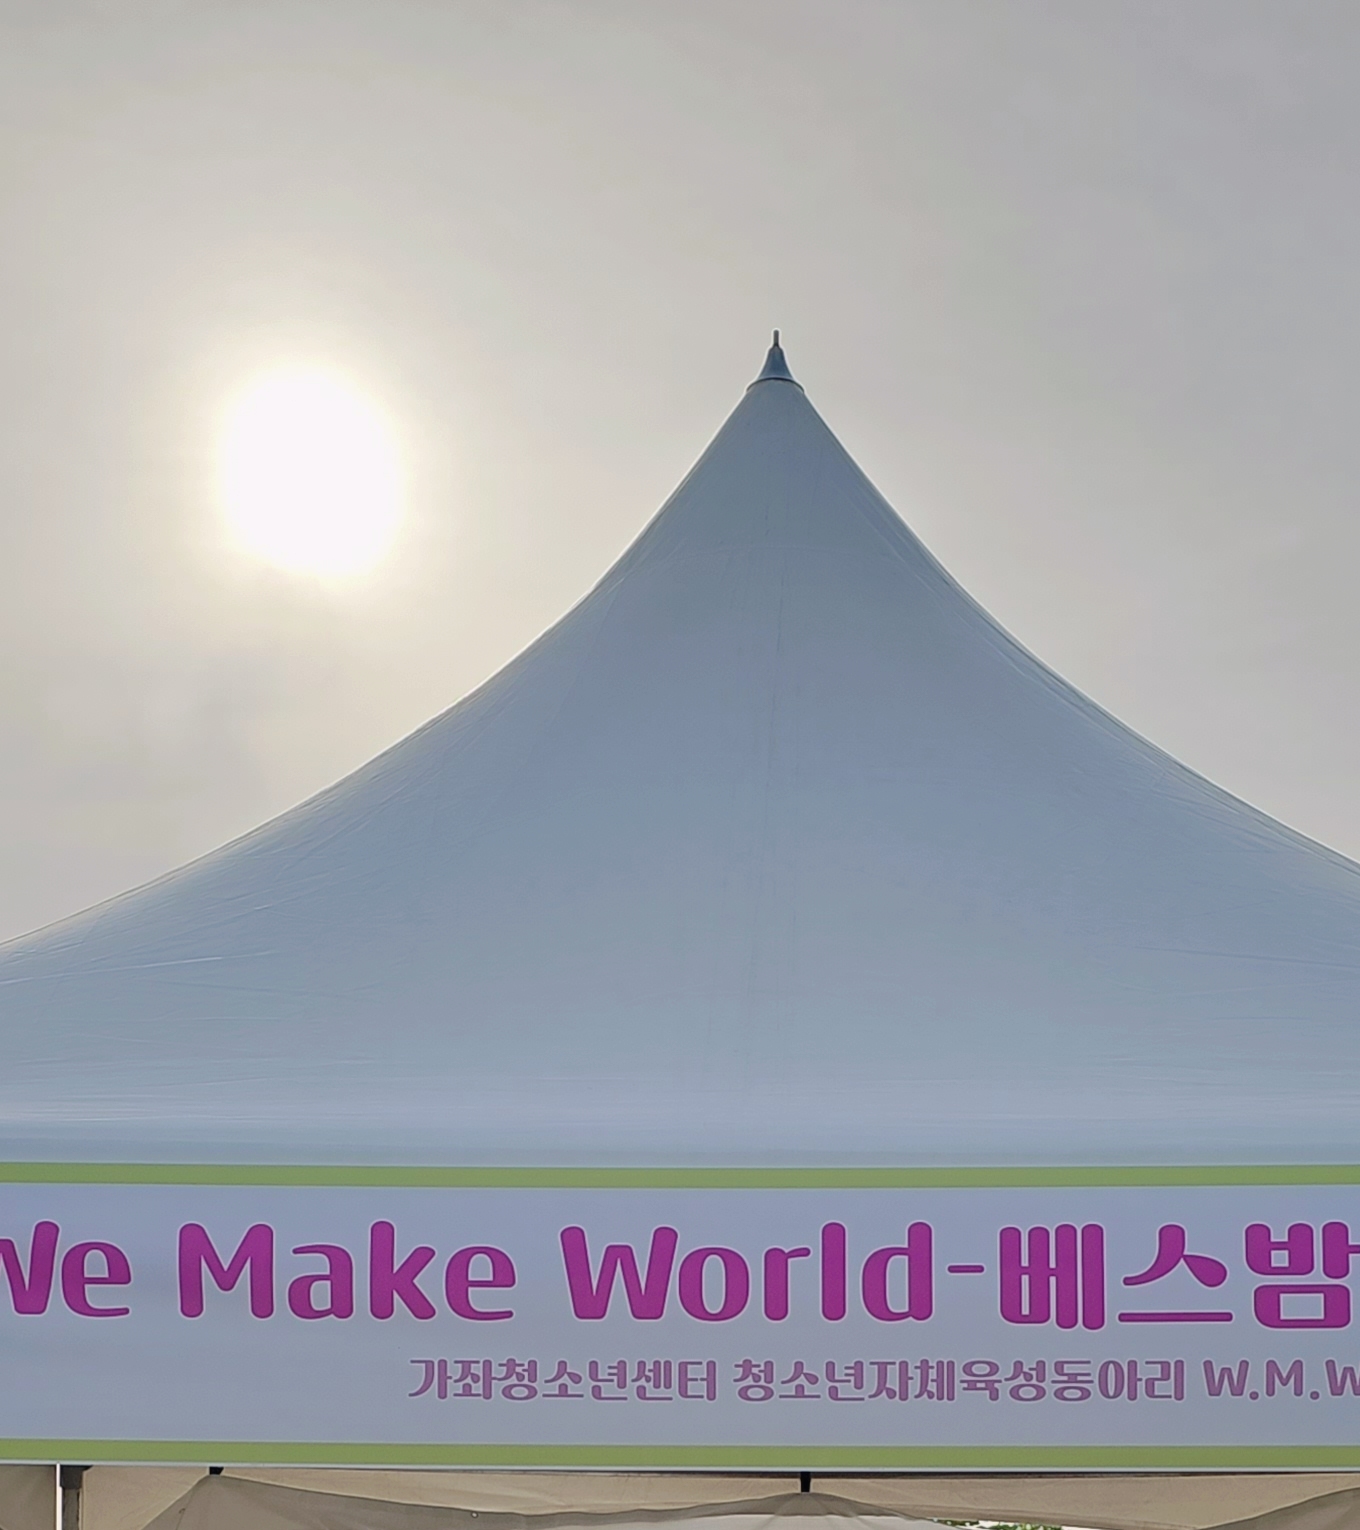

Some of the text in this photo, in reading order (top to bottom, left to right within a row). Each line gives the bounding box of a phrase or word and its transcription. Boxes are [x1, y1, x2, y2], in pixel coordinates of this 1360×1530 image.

[177, 1220, 517, 1322] Make
[408, 1357, 718, 1402] 가좌청소년센터
[733, 1358, 1186, 1403] 청소년자체육성동아리
